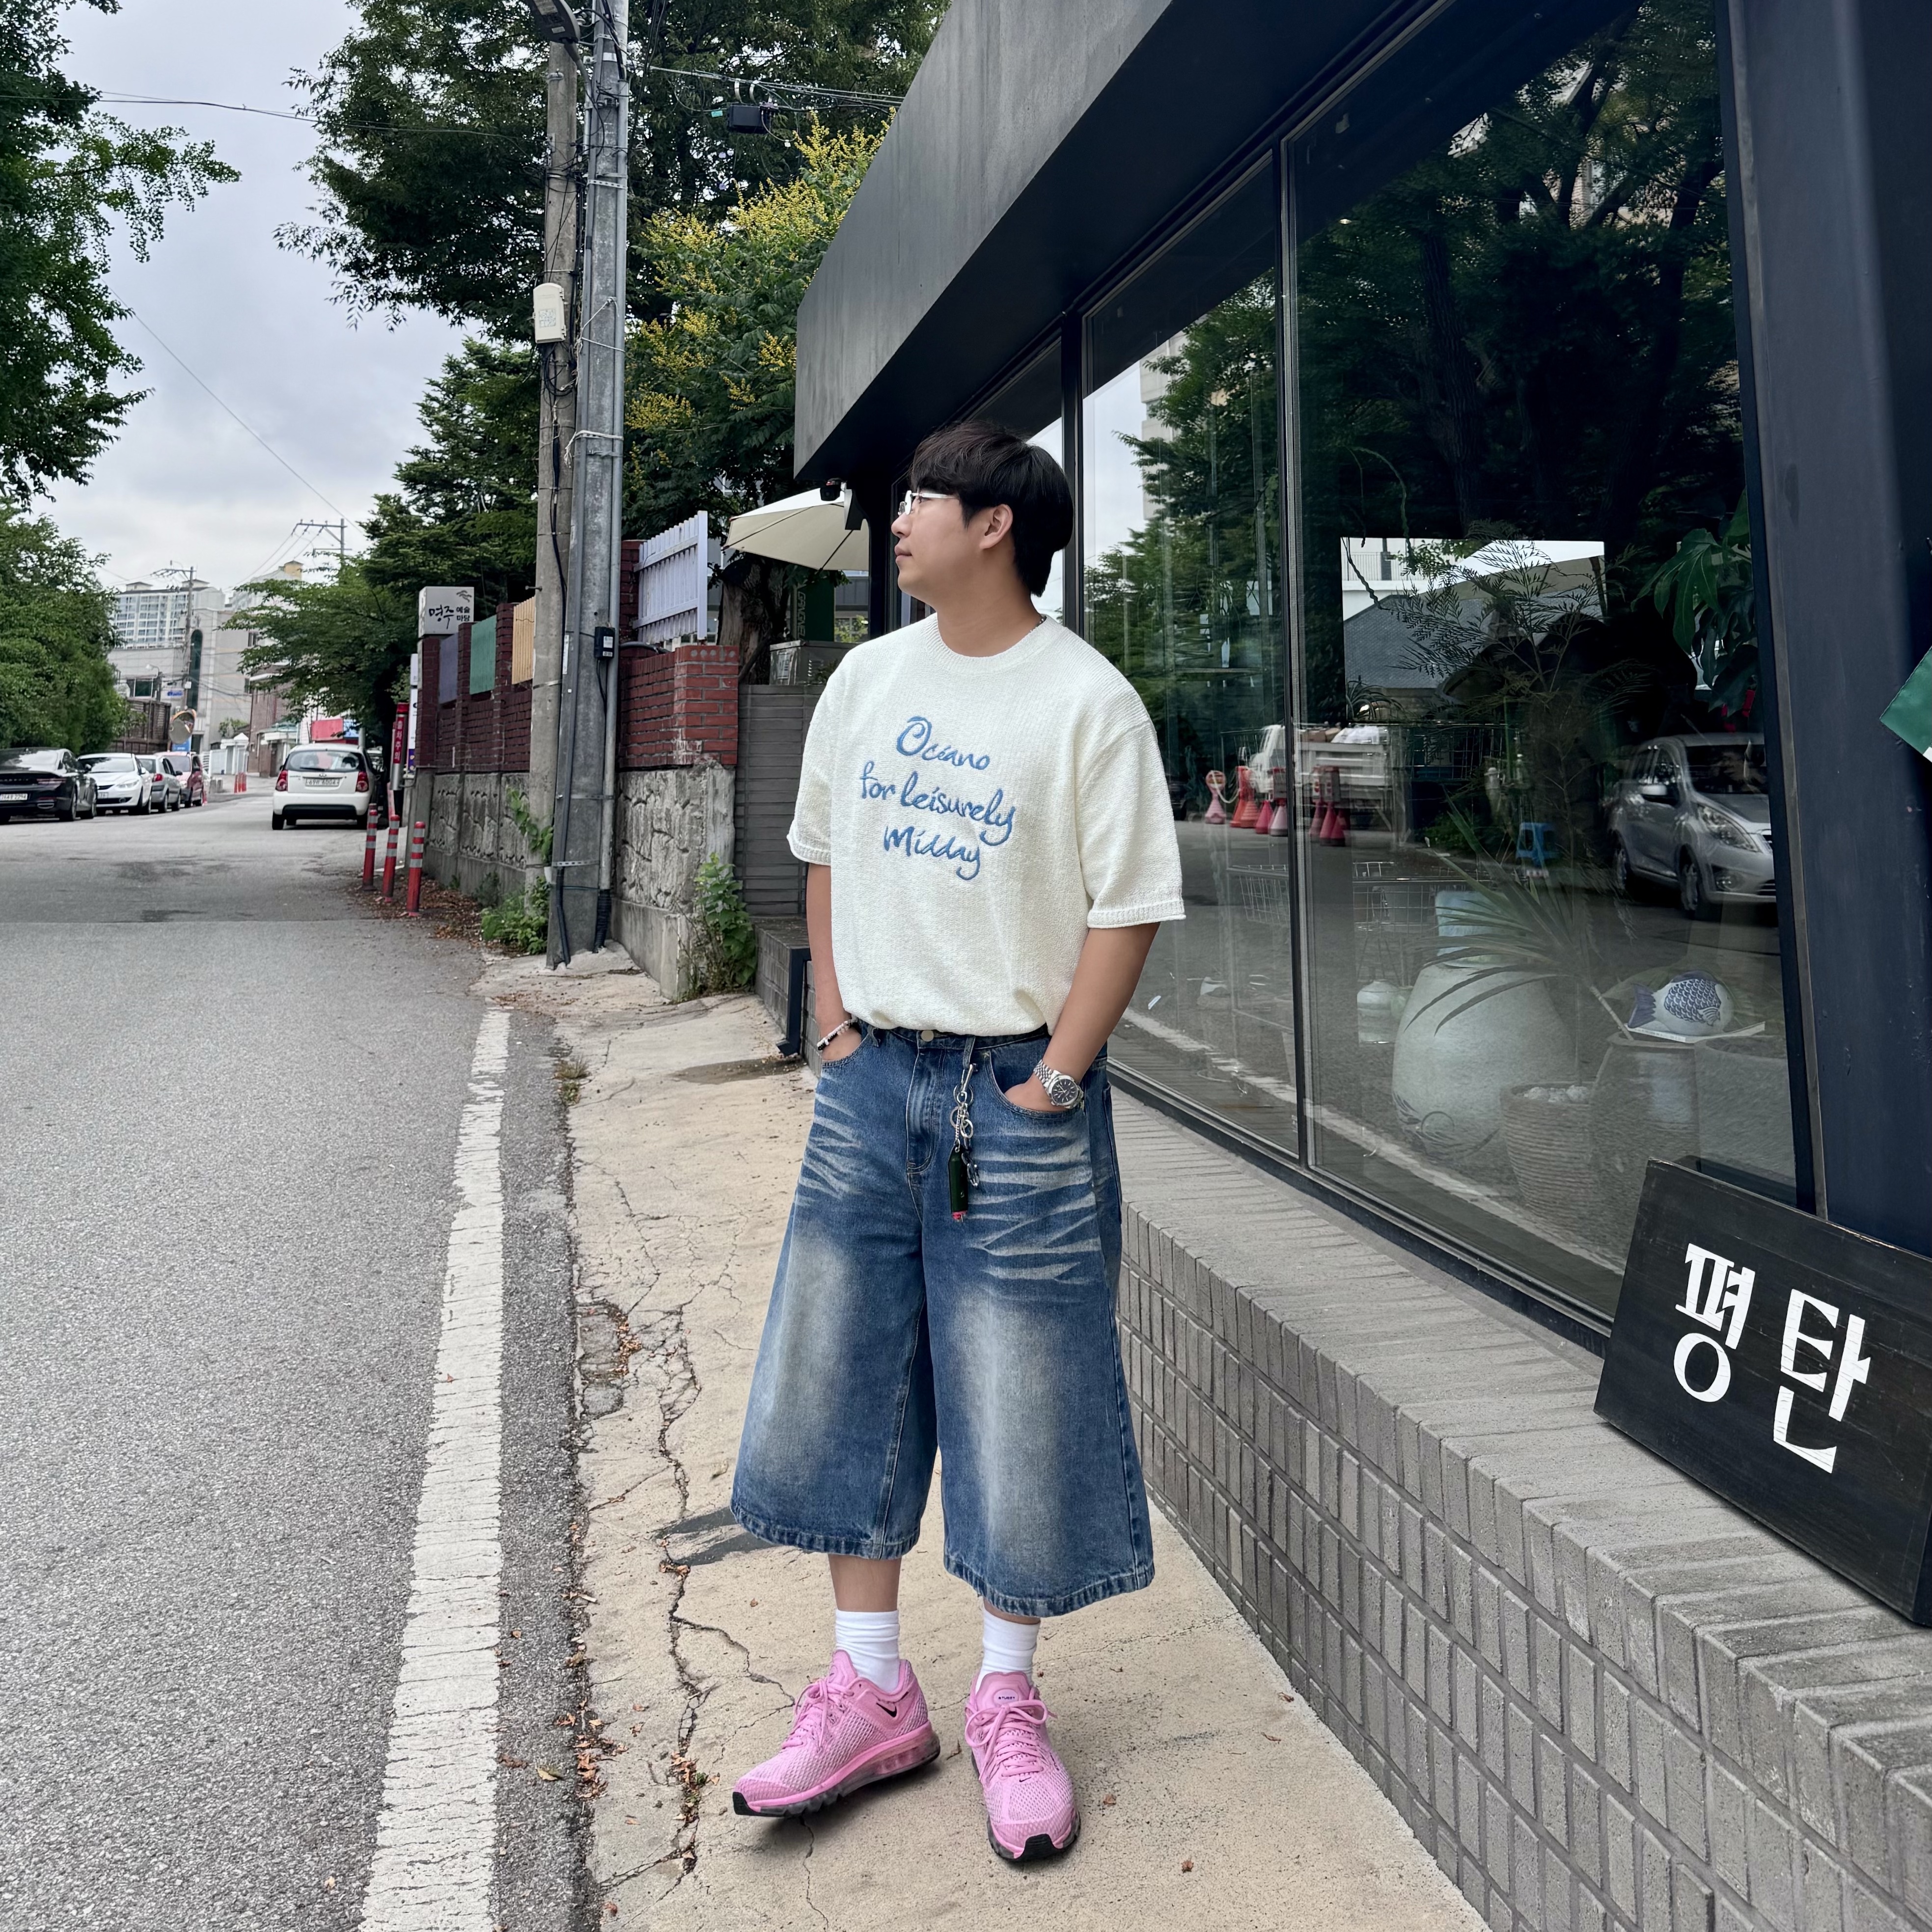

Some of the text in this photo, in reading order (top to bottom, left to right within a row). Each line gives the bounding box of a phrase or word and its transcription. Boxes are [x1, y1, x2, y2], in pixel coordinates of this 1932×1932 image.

[429, 604, 454, 629] 명주
[859, 761, 1016, 846] for leisurely
[1673, 1243, 1871, 1473] 평탄
